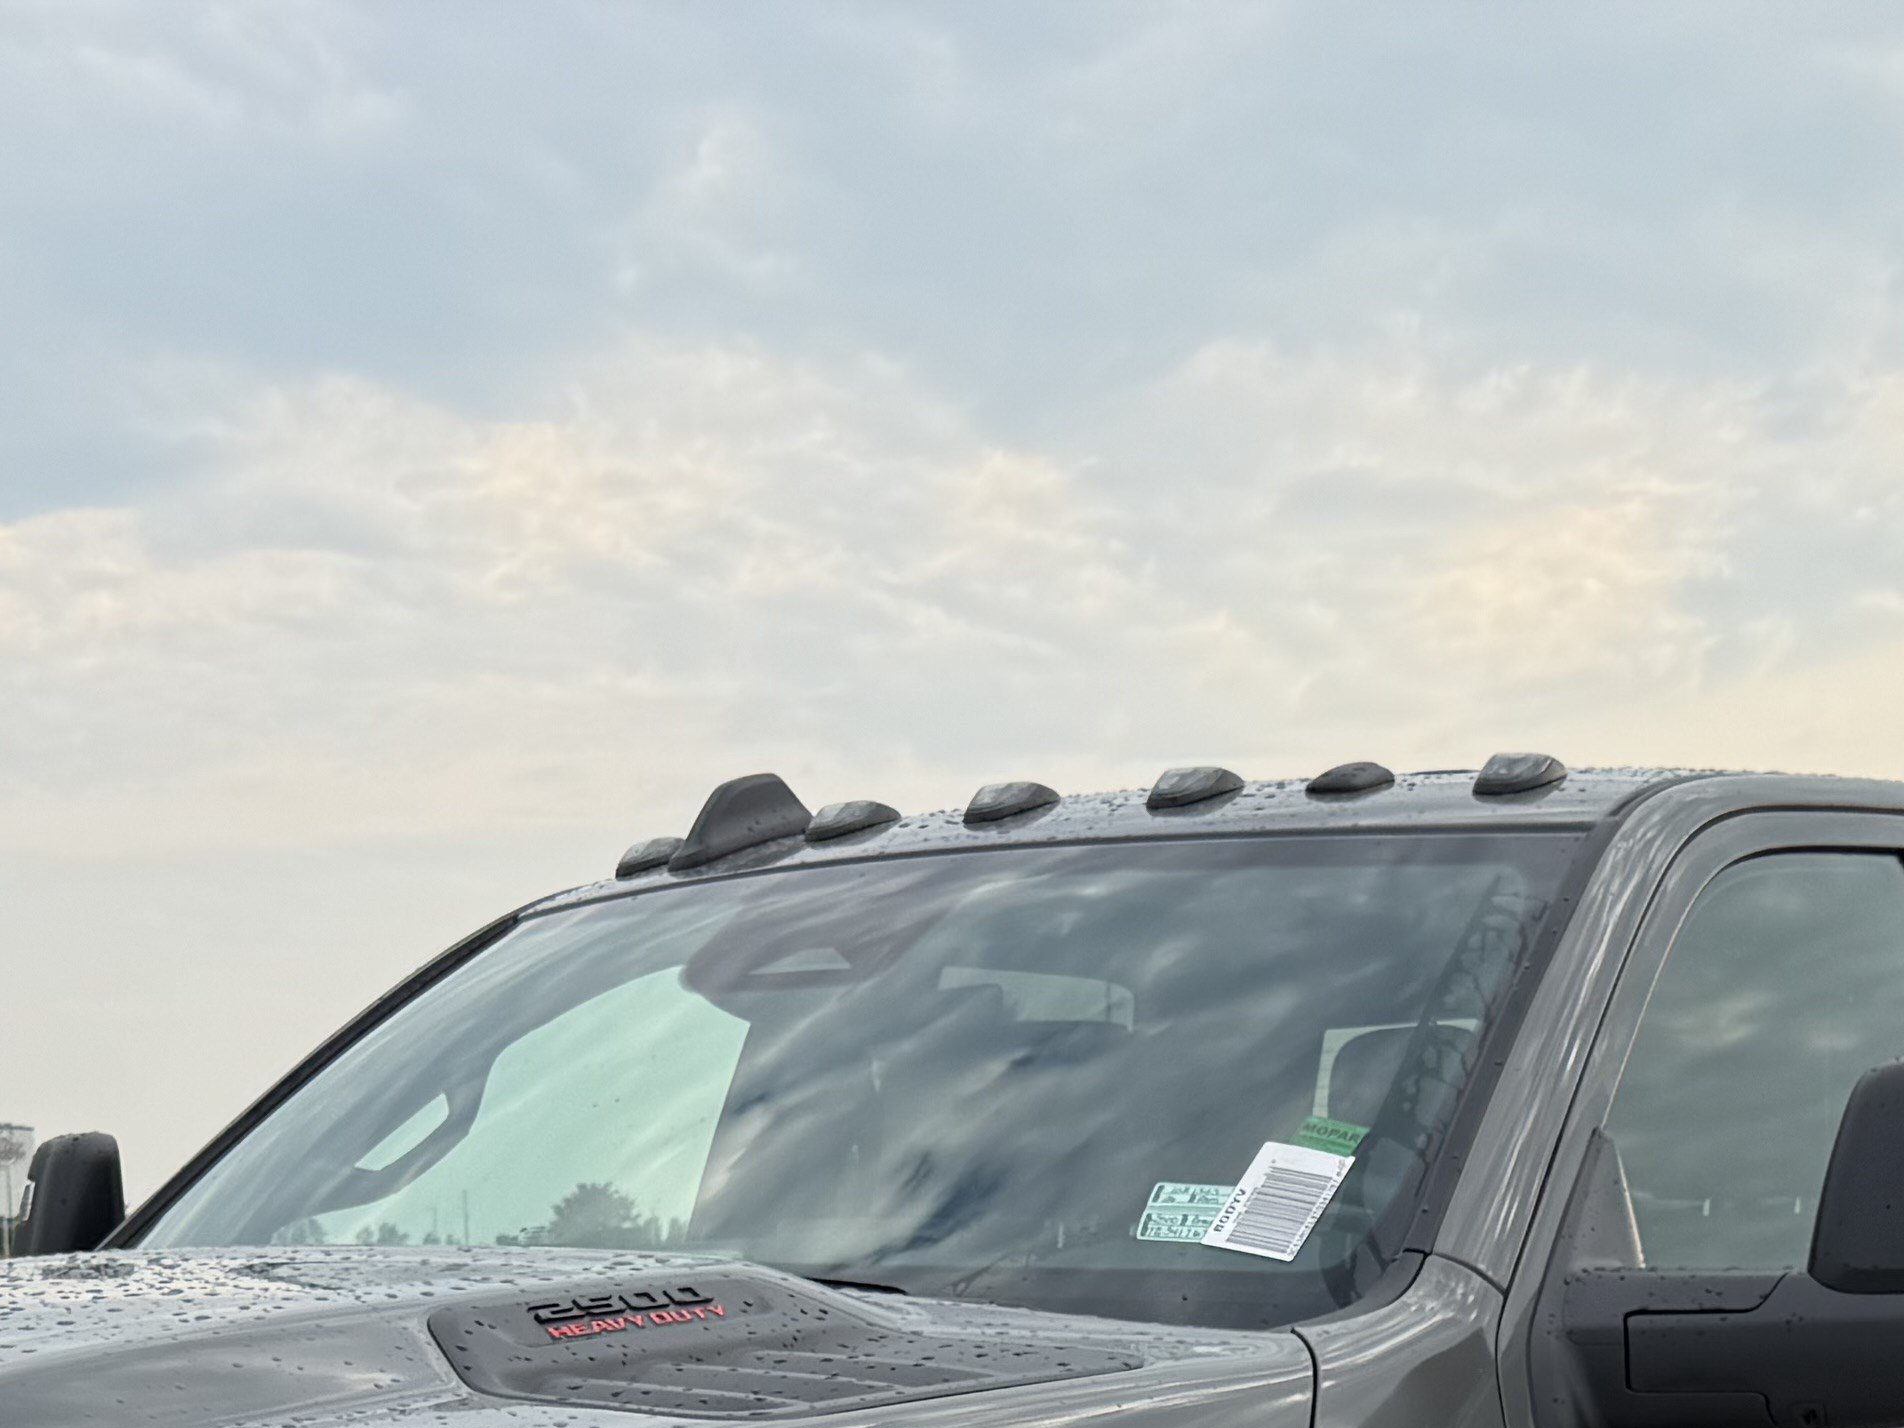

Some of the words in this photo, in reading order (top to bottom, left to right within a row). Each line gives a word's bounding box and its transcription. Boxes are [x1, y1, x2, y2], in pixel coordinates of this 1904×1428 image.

[1302, 1122, 1361, 1143] MOPAR
[526, 1286, 716, 1325] 2500
[548, 1312, 646, 1339] HEAVY
[649, 1304, 727, 1326] DUTY
